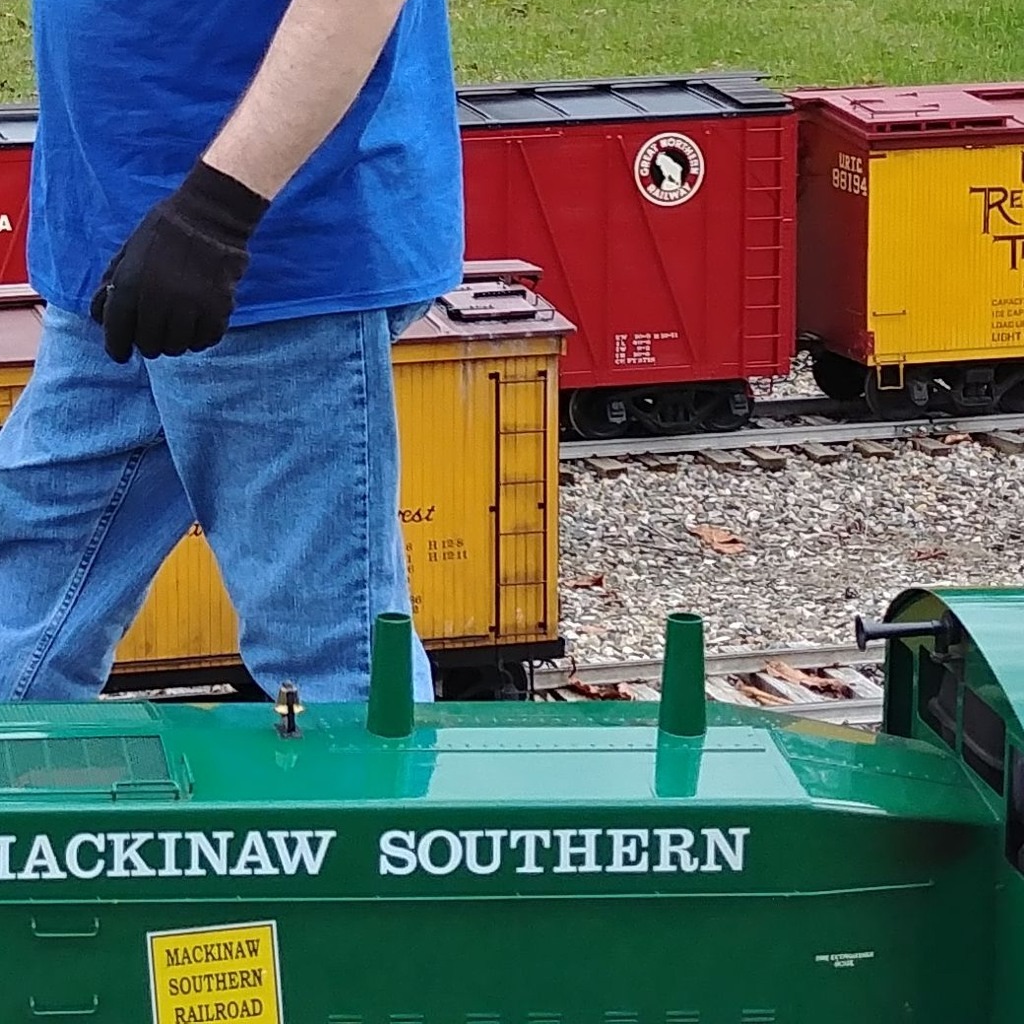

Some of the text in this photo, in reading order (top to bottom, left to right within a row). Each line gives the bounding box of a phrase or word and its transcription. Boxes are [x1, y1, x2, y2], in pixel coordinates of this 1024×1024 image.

[640, 143, 658, 176] GREAT
[647, 181, 691, 200] RAILWAY
[832, 168, 867, 196] 88194
[992, 332, 1021, 342] LIGHT
[398, 505, 435, 523] est
[378, 827, 751, 875] SOUTHERN
[165, 939, 260, 967] MACKINAW
[169, 968, 263, 996] SOUTHERN
[174, 998, 264, 1024] RAILROAD
